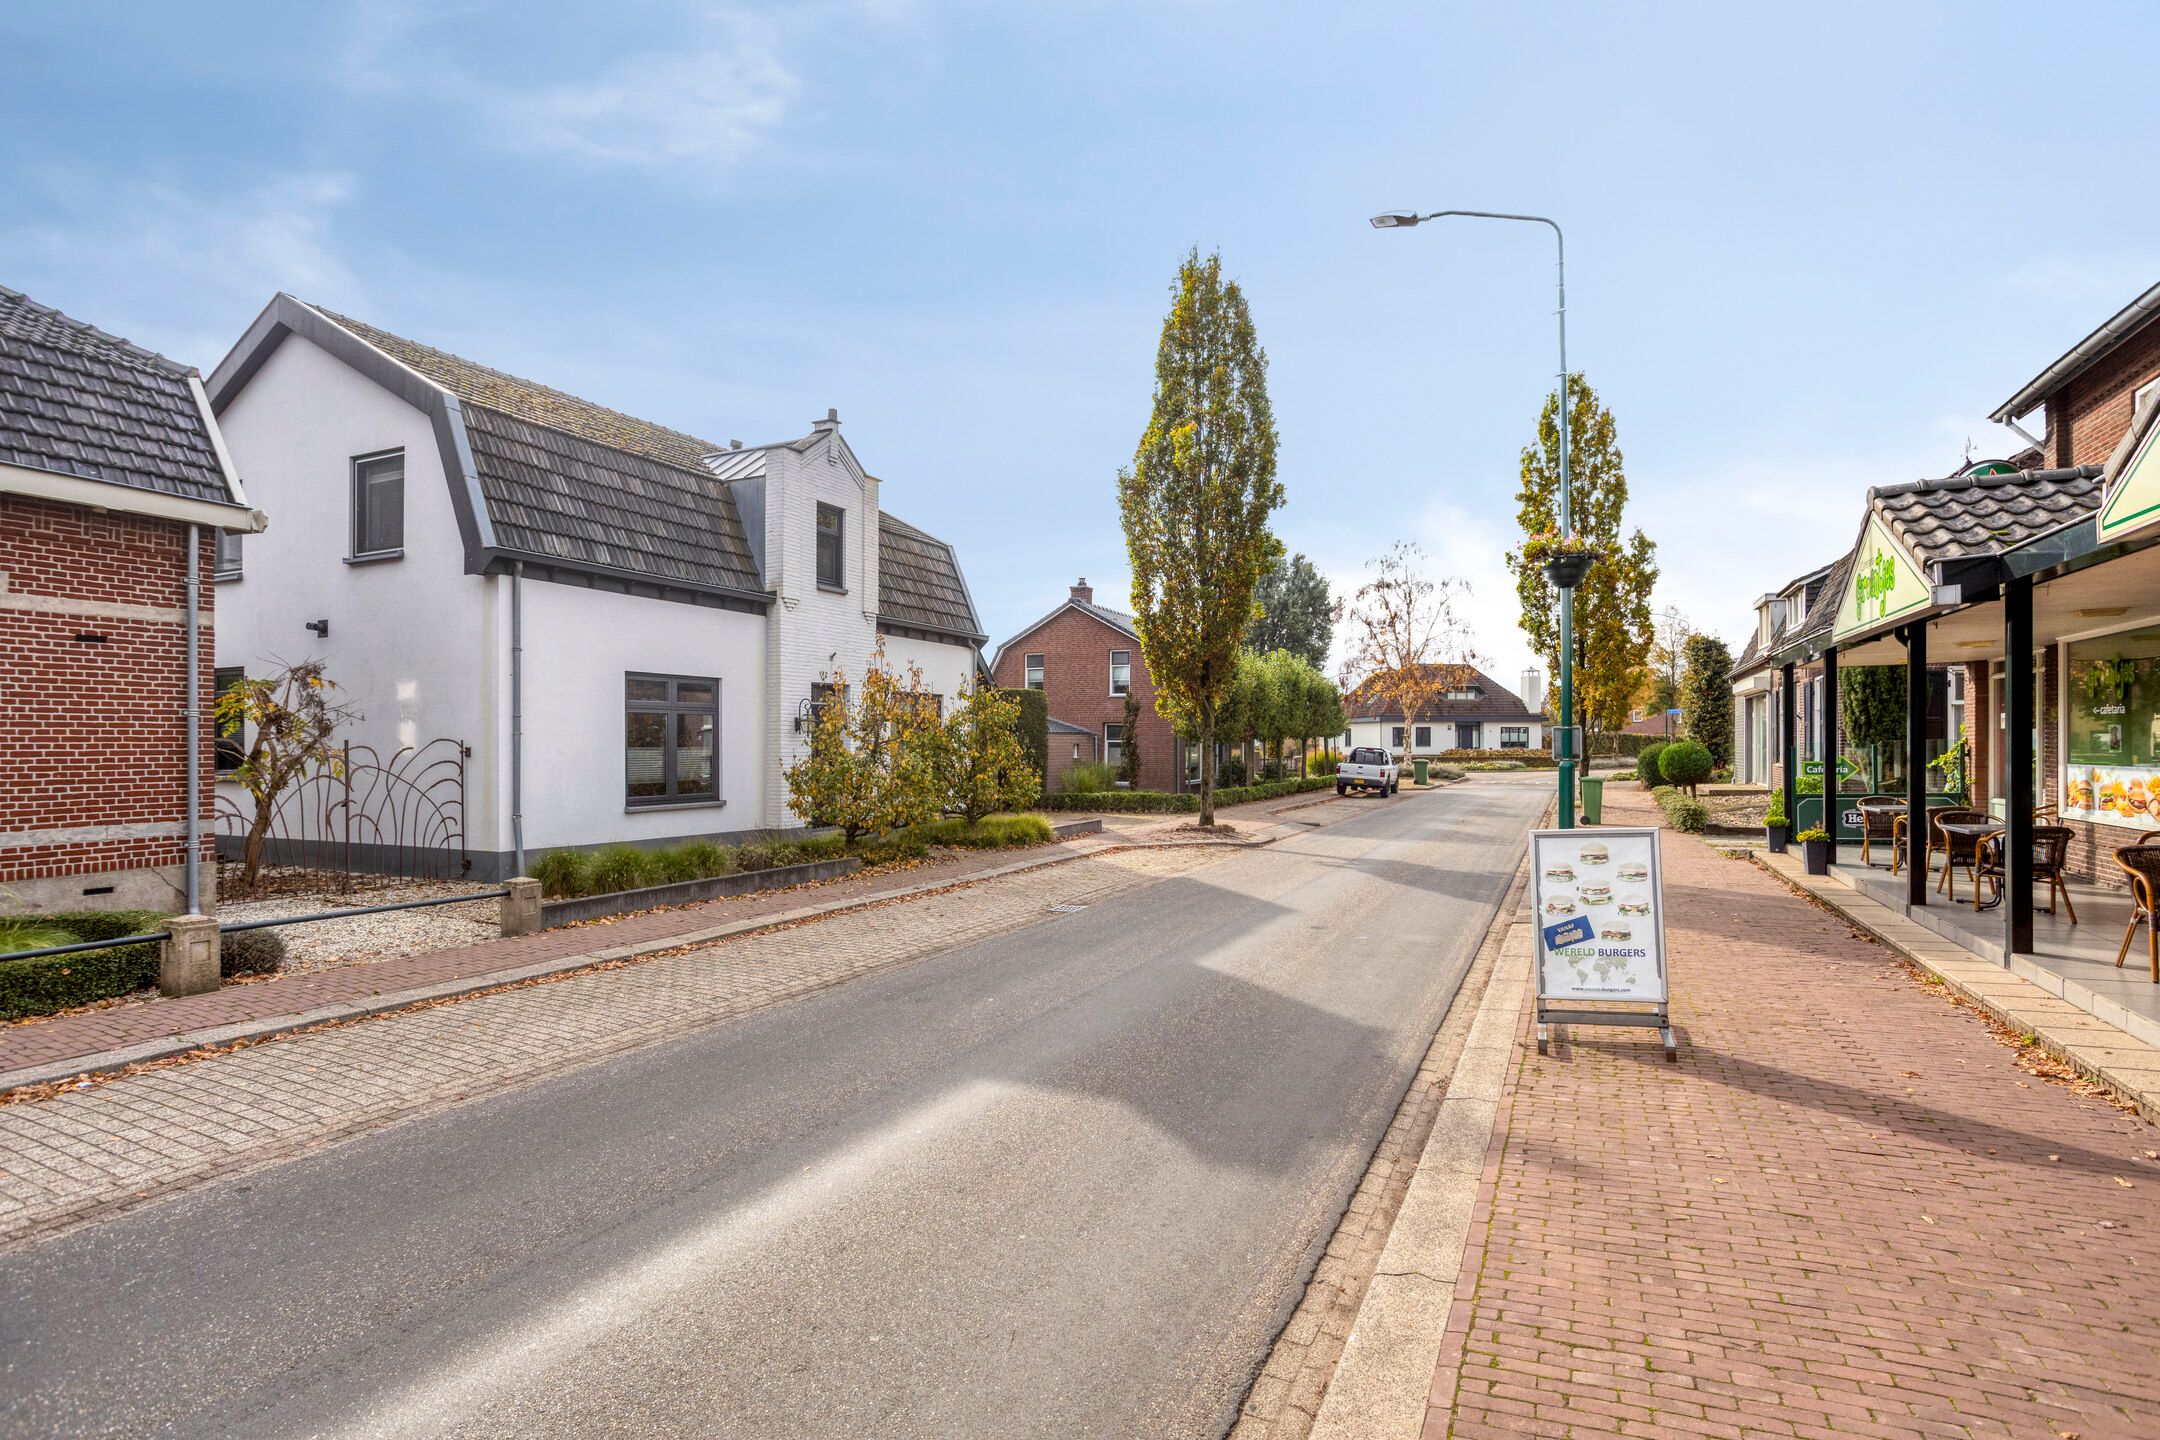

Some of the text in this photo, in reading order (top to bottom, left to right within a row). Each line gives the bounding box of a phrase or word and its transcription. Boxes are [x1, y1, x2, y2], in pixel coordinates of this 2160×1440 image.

[2100, 704, 2125, 714] cafetaria
[1554, 948, 1646, 957] WERELD BURGERS
